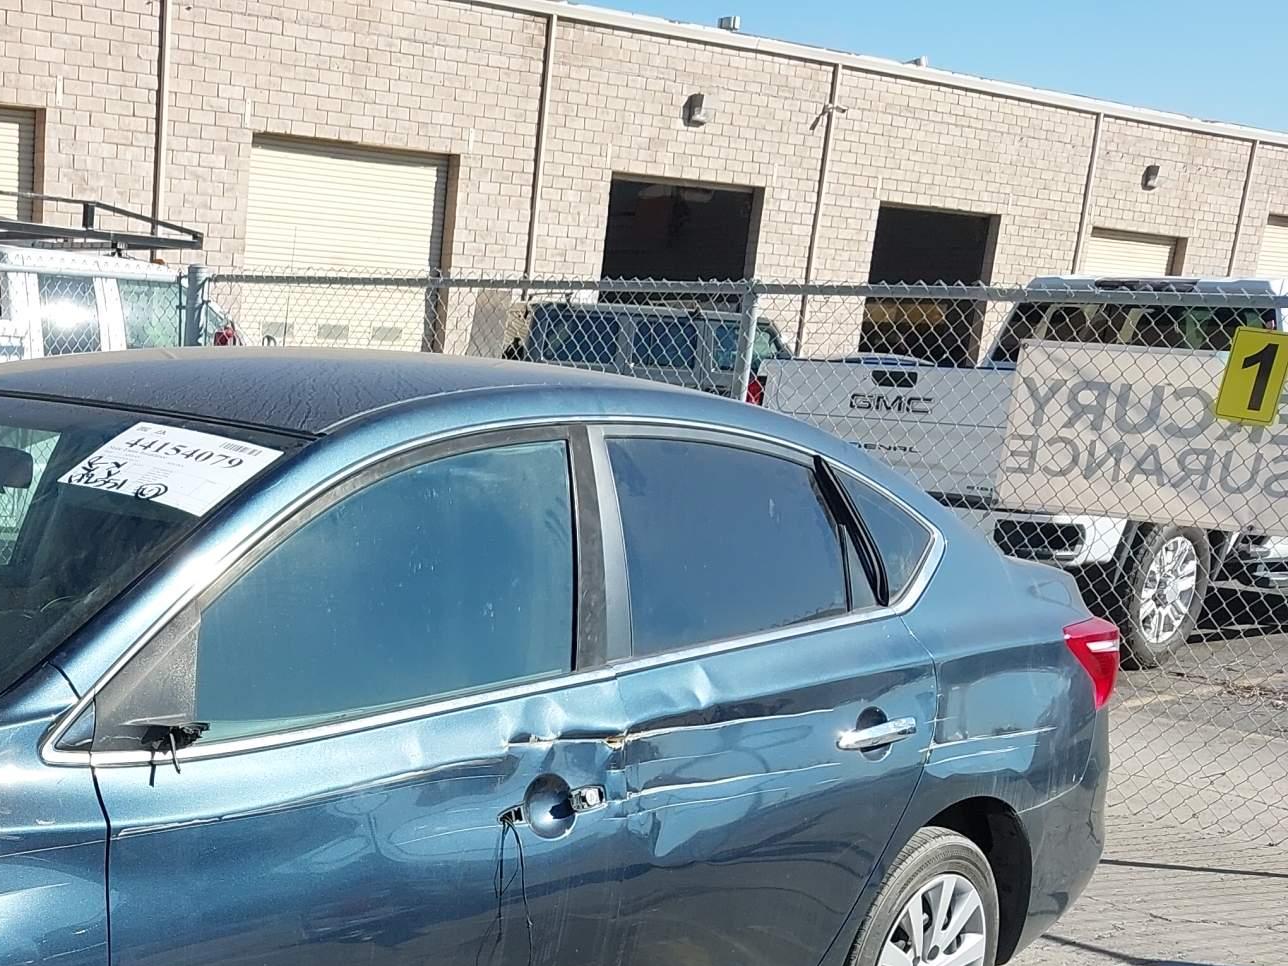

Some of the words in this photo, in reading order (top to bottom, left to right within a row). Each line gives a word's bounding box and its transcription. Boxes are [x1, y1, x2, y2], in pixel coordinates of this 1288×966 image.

[1242, 343, 1280, 411] 1
[850, 393, 932, 413] GMC
[125, 437, 244, 468] 44154079
[849, 441, 921, 453] DENAL
